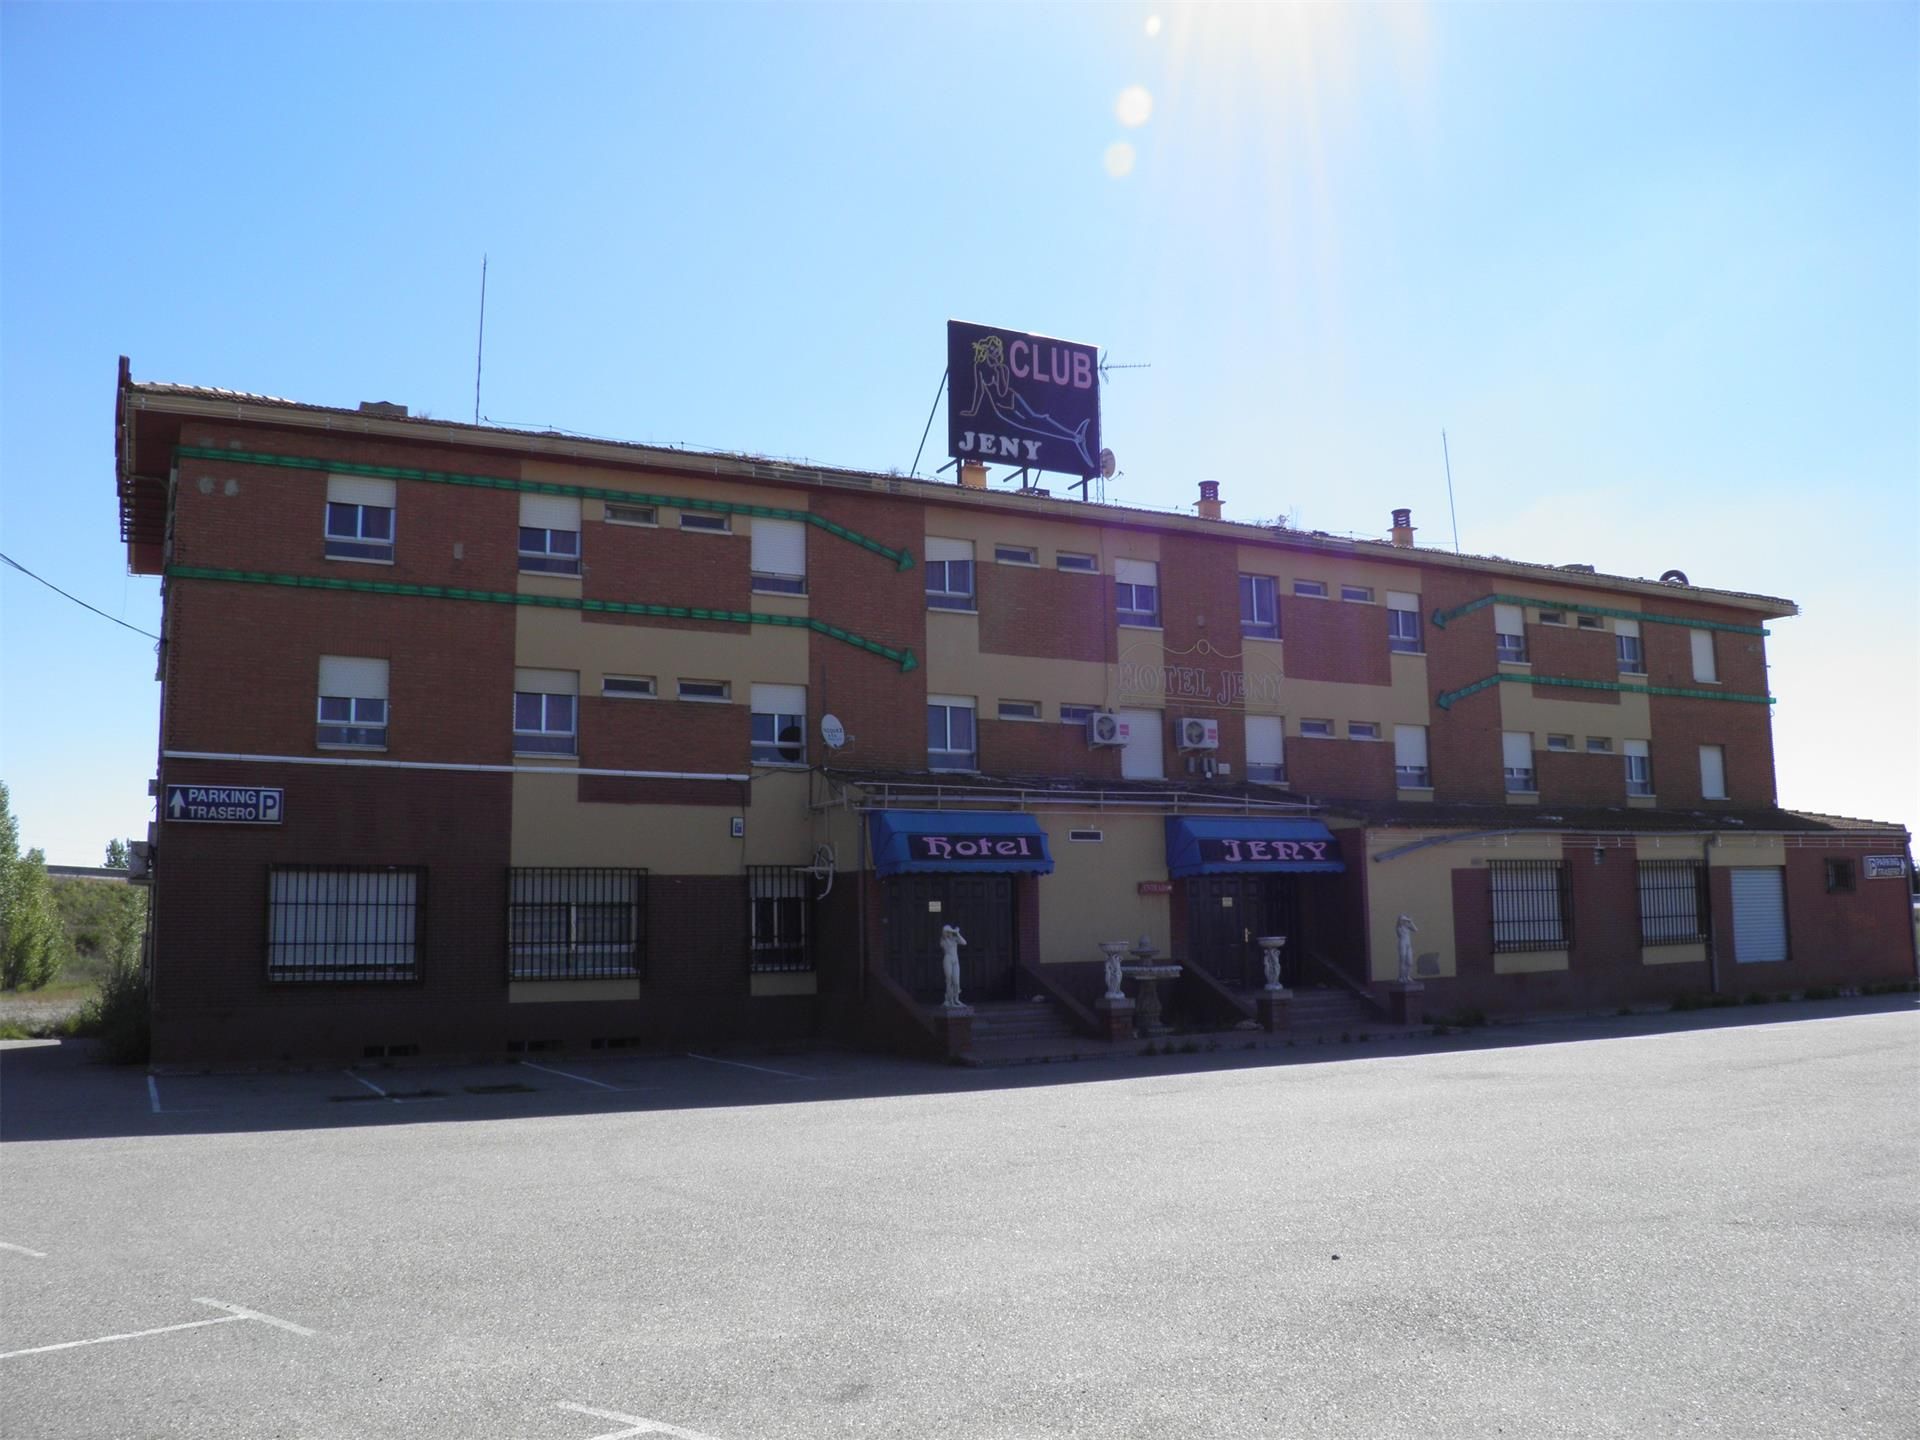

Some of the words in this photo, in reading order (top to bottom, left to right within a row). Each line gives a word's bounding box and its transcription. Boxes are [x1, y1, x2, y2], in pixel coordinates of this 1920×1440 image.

[1009, 340, 1092, 389] CLUB
[958, 431, 1042, 460] JENY
[1119, 663, 1211, 697] HOTEL
[1217, 669, 1285, 706] JENY
[188, 789, 257, 804] PARKING
[262, 793, 278, 819] P
[188, 806, 256, 820] TRASERO
[1222, 839, 1327, 861] JENY
